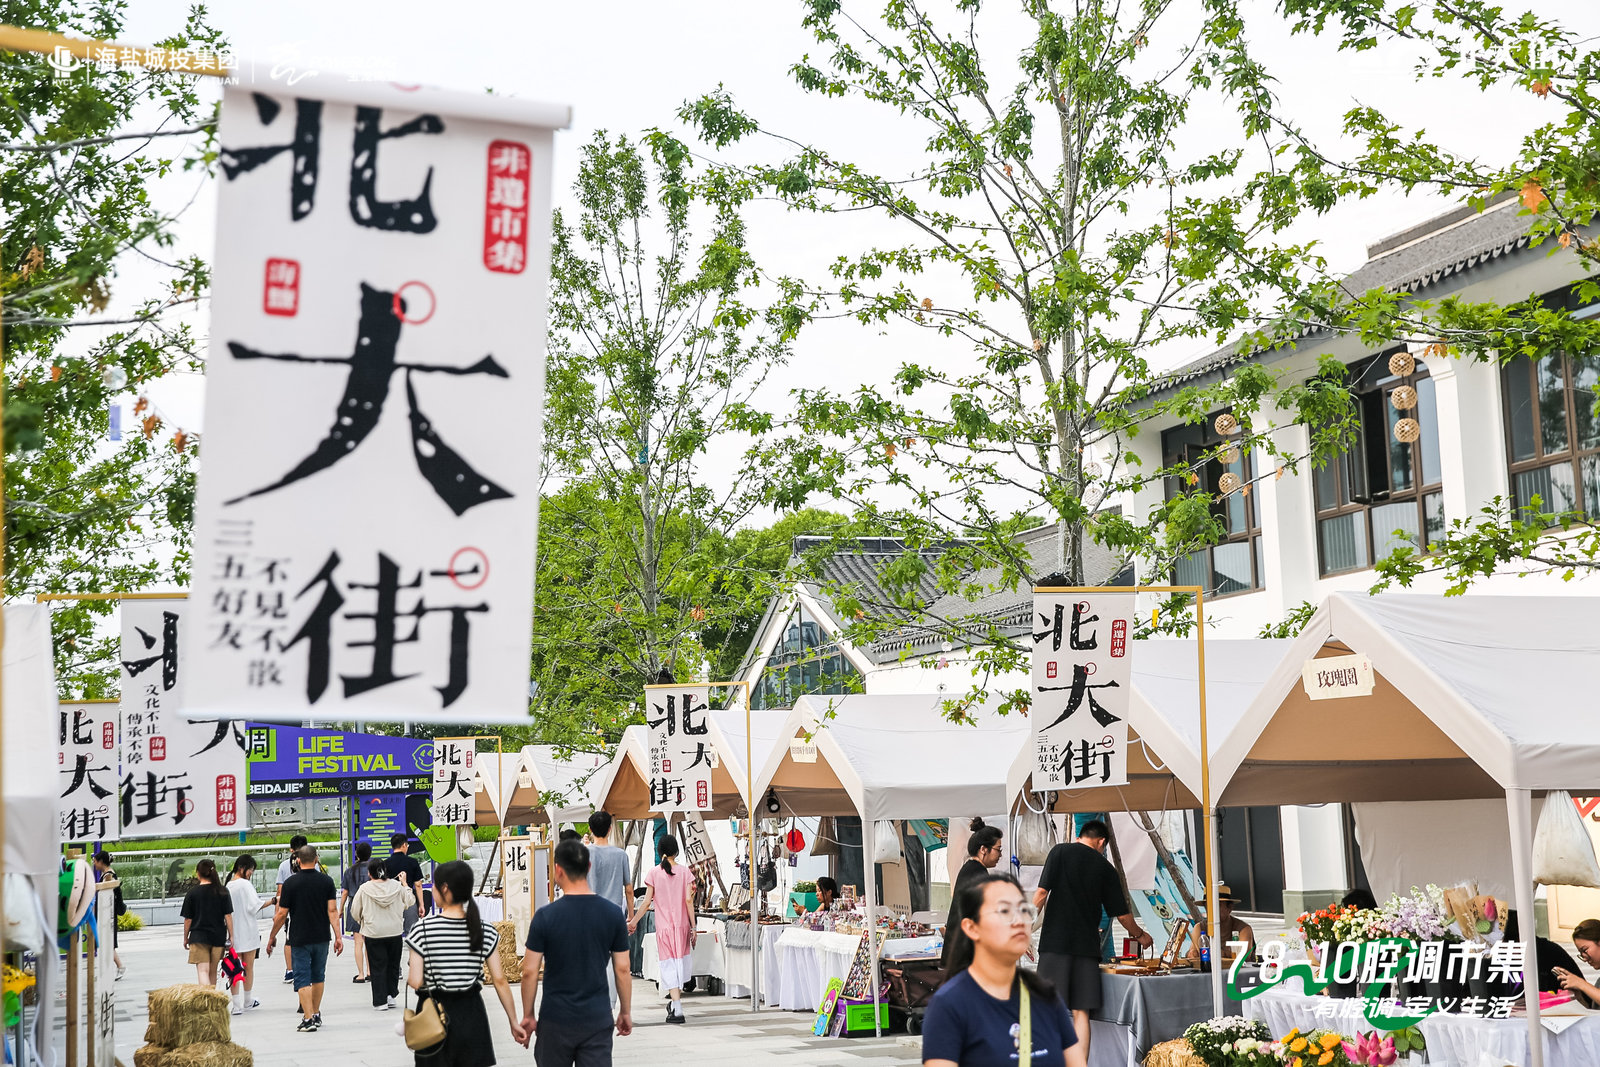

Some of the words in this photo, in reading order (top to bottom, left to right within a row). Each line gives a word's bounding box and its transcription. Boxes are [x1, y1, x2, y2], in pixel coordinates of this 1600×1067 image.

[221, 91, 512, 708] 北大街
[209, 519, 253, 651] 三五好友
[248, 557, 293, 688] 不見不散
[144, 684, 160, 735] 文化不止
[1032, 604, 1122, 786] 北大街
[126, 713, 143, 764] 傳承不停
[298, 736, 344, 754] LIFE
[298, 754, 401, 774] FESTIVAL
[647, 694, 711, 806] 北大街
[433, 744, 472, 823] 北大街
[505, 846, 527, 872] 北
